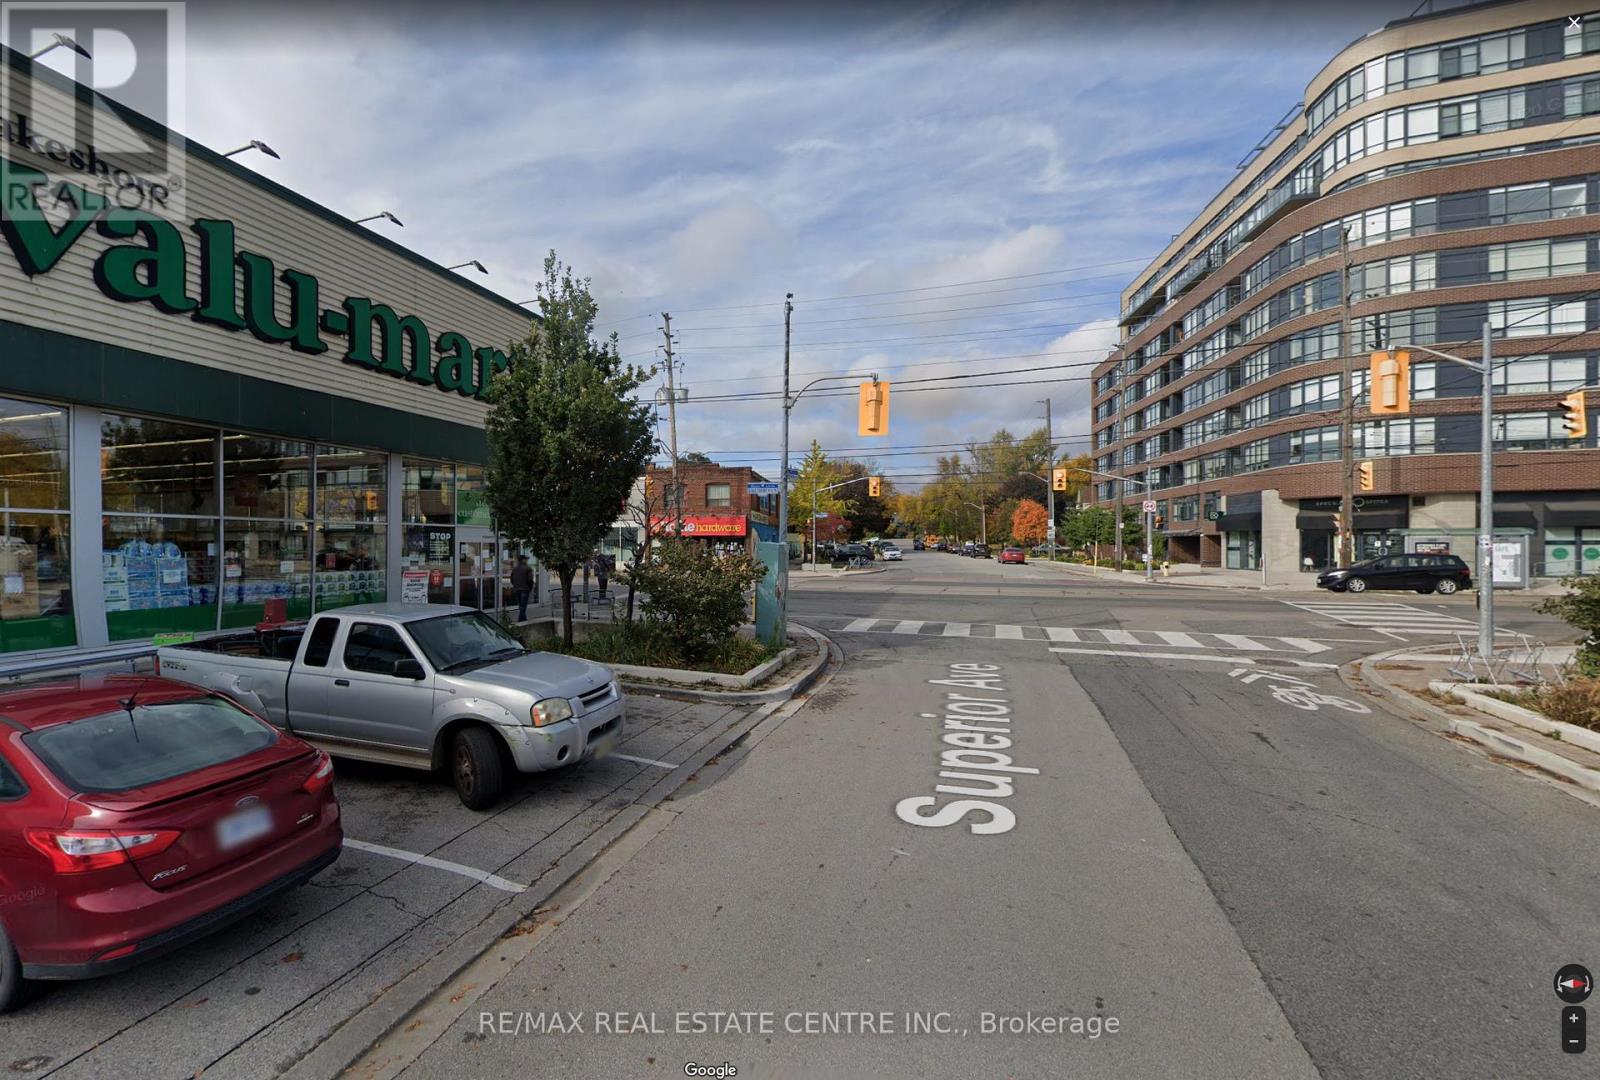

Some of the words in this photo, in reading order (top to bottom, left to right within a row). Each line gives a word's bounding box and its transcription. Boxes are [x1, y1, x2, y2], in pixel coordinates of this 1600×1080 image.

[0, 156, 517, 404] valu-mar
[695, 522, 742, 533] hardware
[429, 532, 452, 540] STOP
